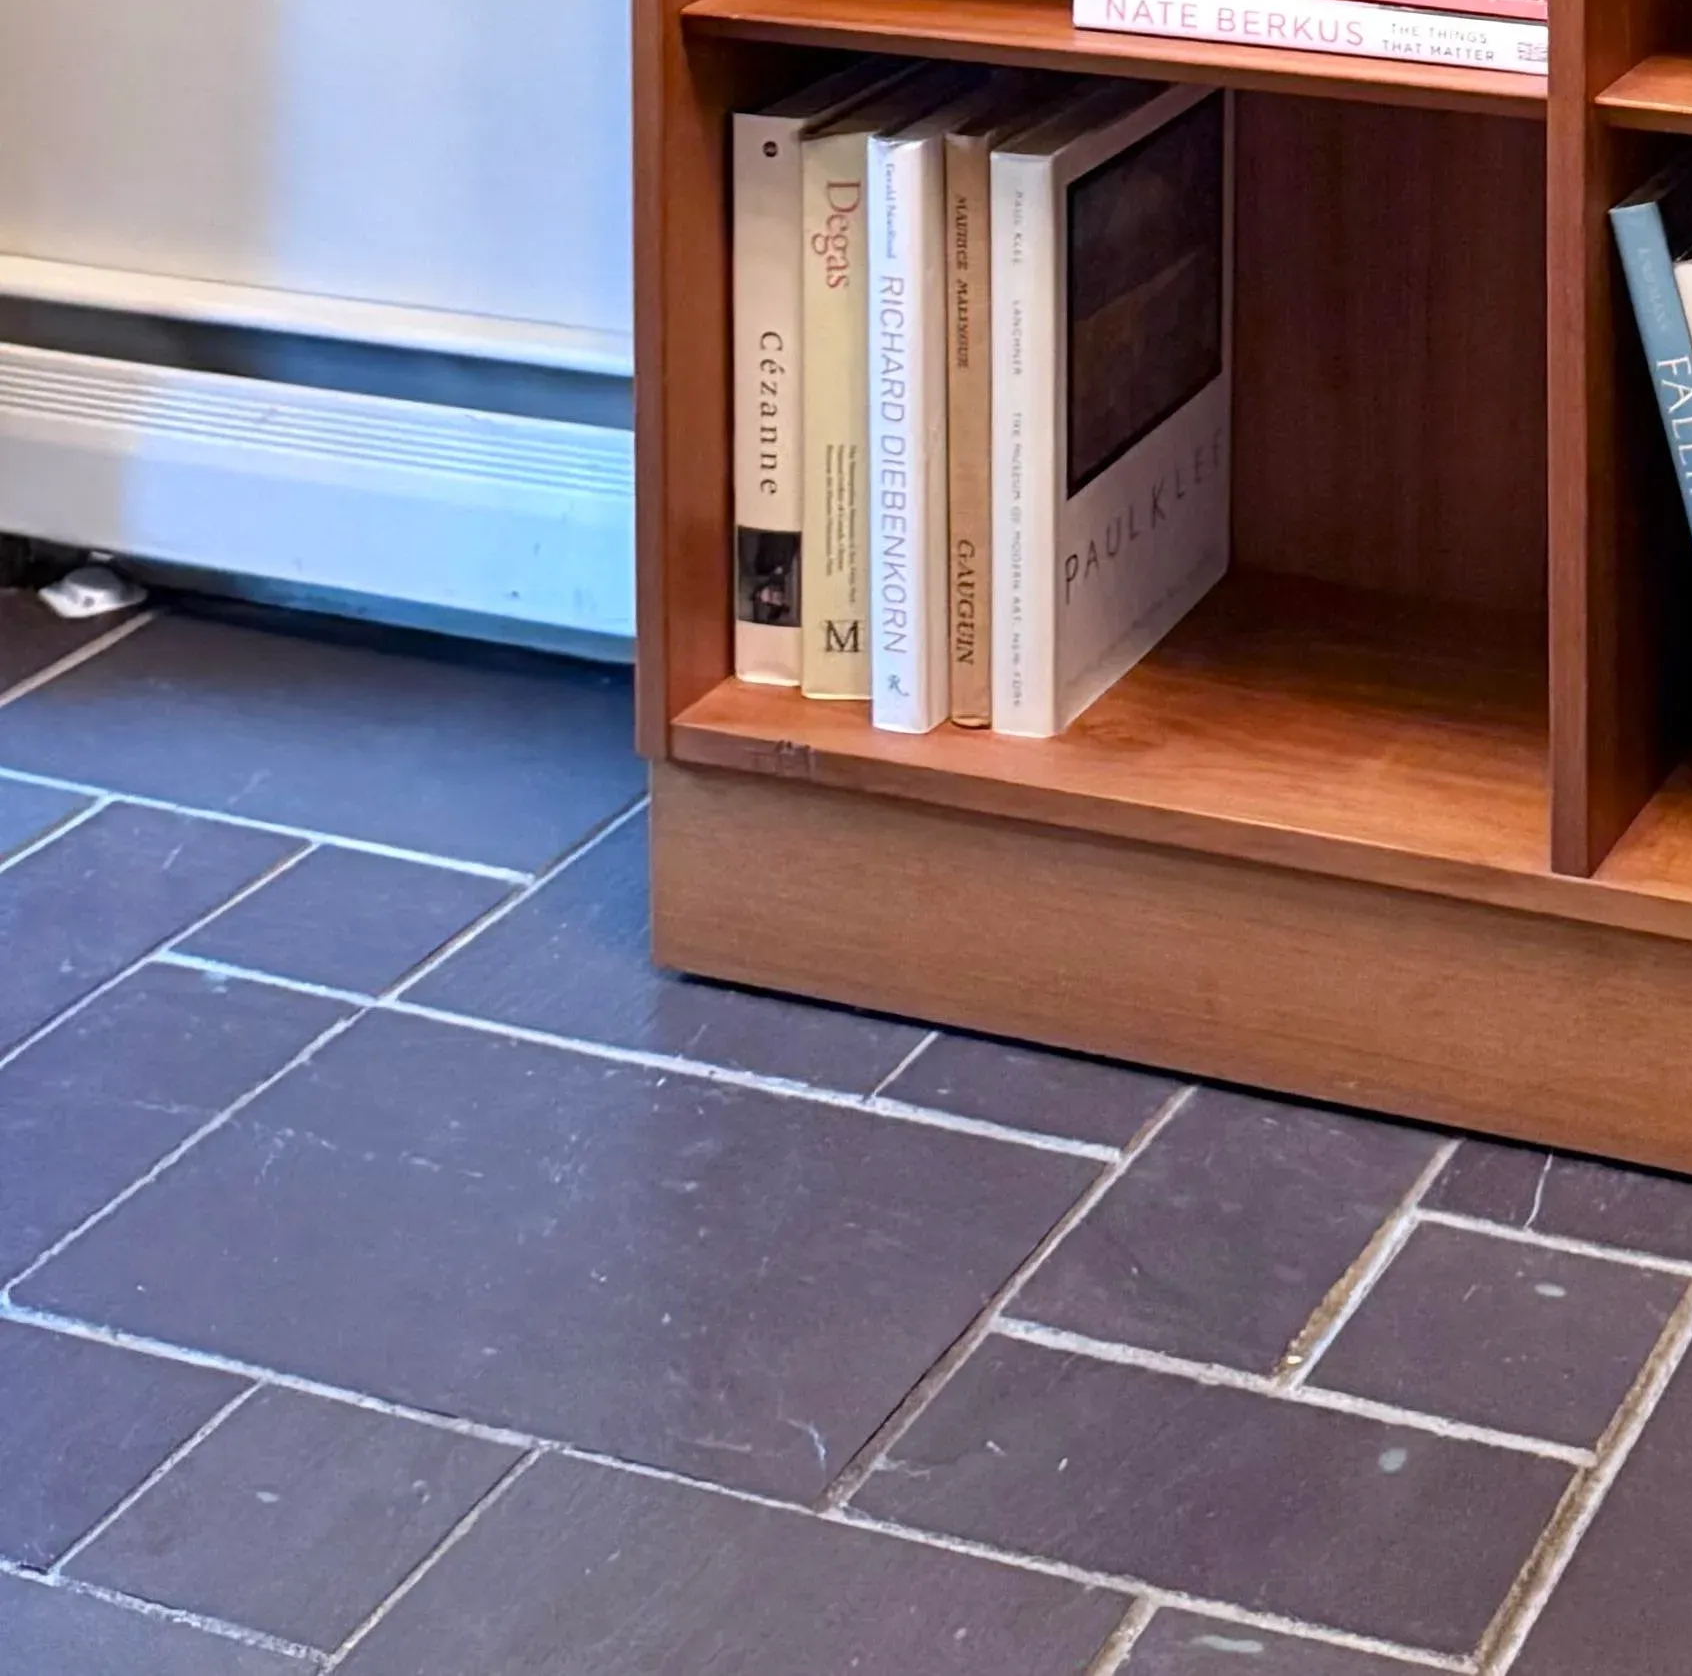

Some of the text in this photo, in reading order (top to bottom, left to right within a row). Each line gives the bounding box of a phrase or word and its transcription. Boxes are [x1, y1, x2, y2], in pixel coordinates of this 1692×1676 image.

[1216, 6, 1364, 47] BERKUS
[1382, 39, 1495, 62] THAT MATTER
[1391, 23, 1488, 45] THE THINGS
[811, 180, 862, 289] Degas
[759, 330, 786, 497] Cézanne
[879, 275, 908, 654] RICHARD DIEBENKORN
[956, 538, 976, 666] GAUGUIN
[1063, 502, 1140, 607] PAUL
